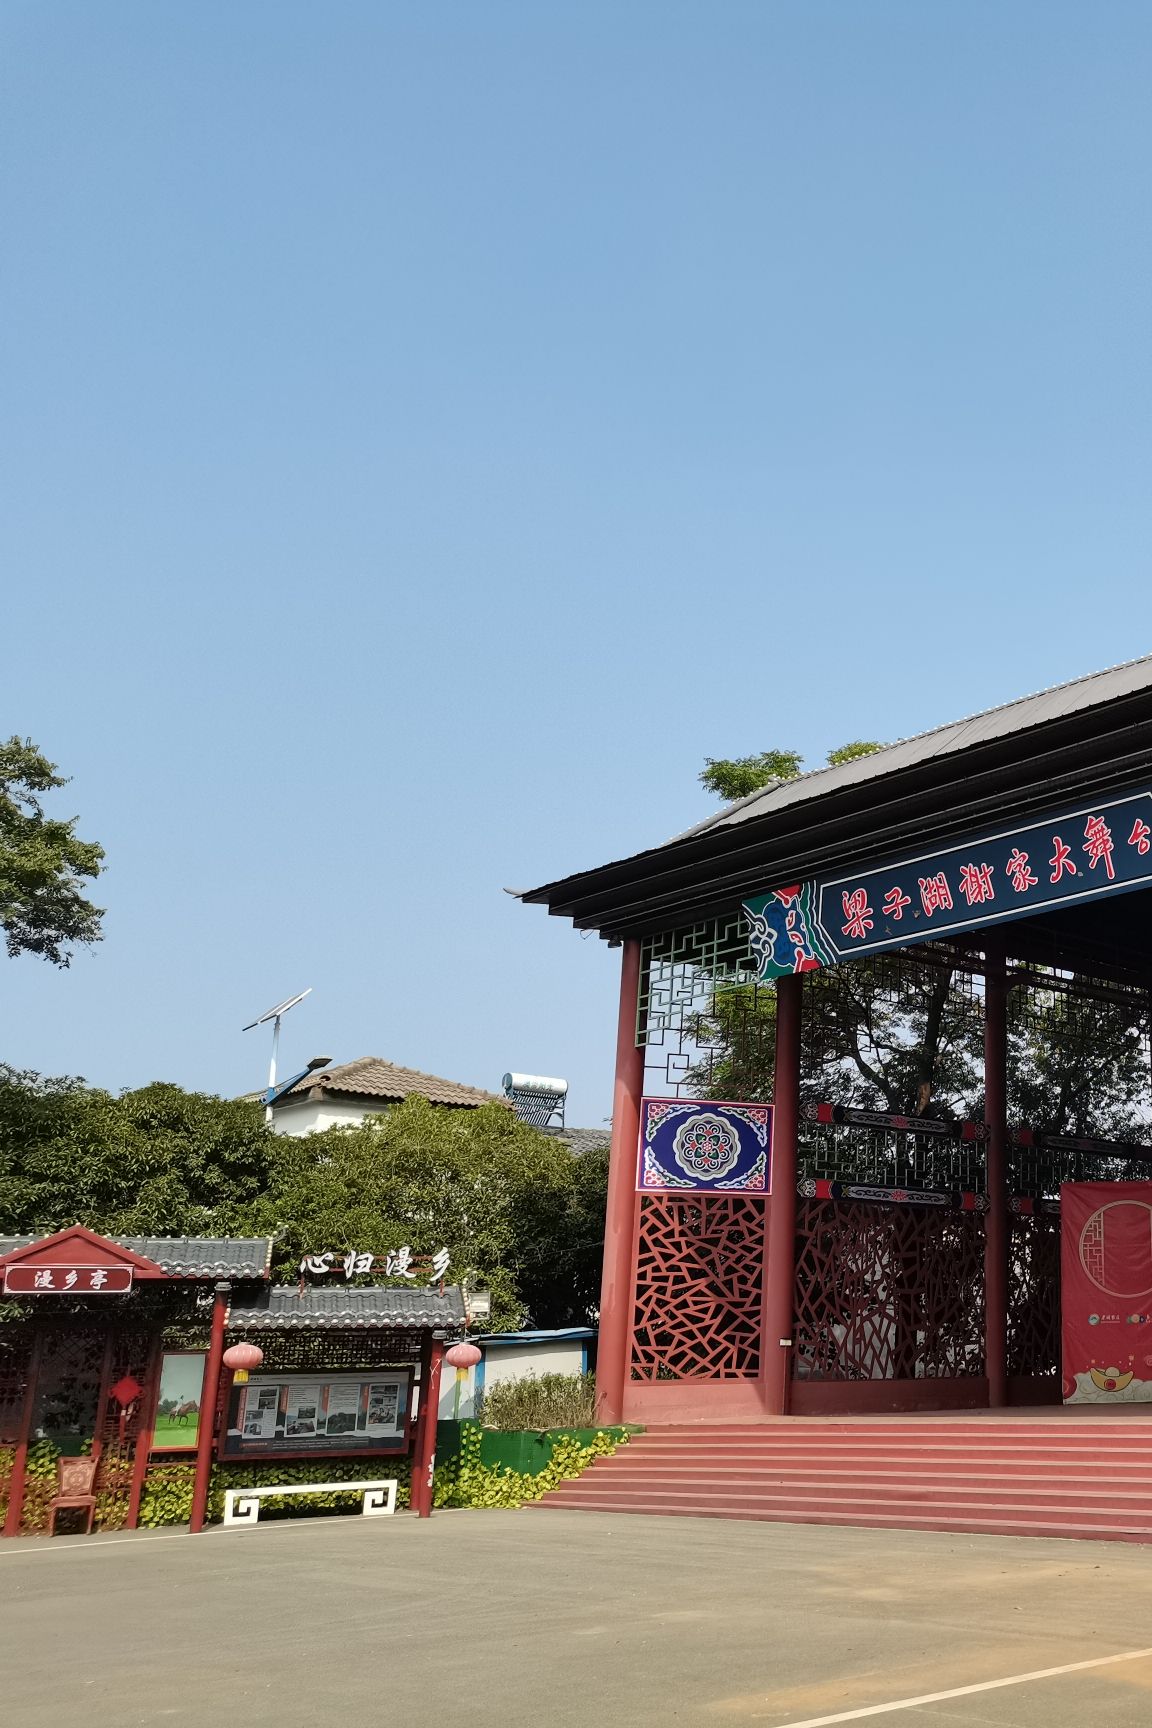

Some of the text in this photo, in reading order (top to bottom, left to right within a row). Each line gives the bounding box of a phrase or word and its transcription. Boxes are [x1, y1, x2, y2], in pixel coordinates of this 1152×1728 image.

[841, 815, 1151, 939] 梁子湖谢家大舞台
[33, 1269, 109, 1291] 漫乡亭
[301, 1246, 451, 1282] 心归漫乡
